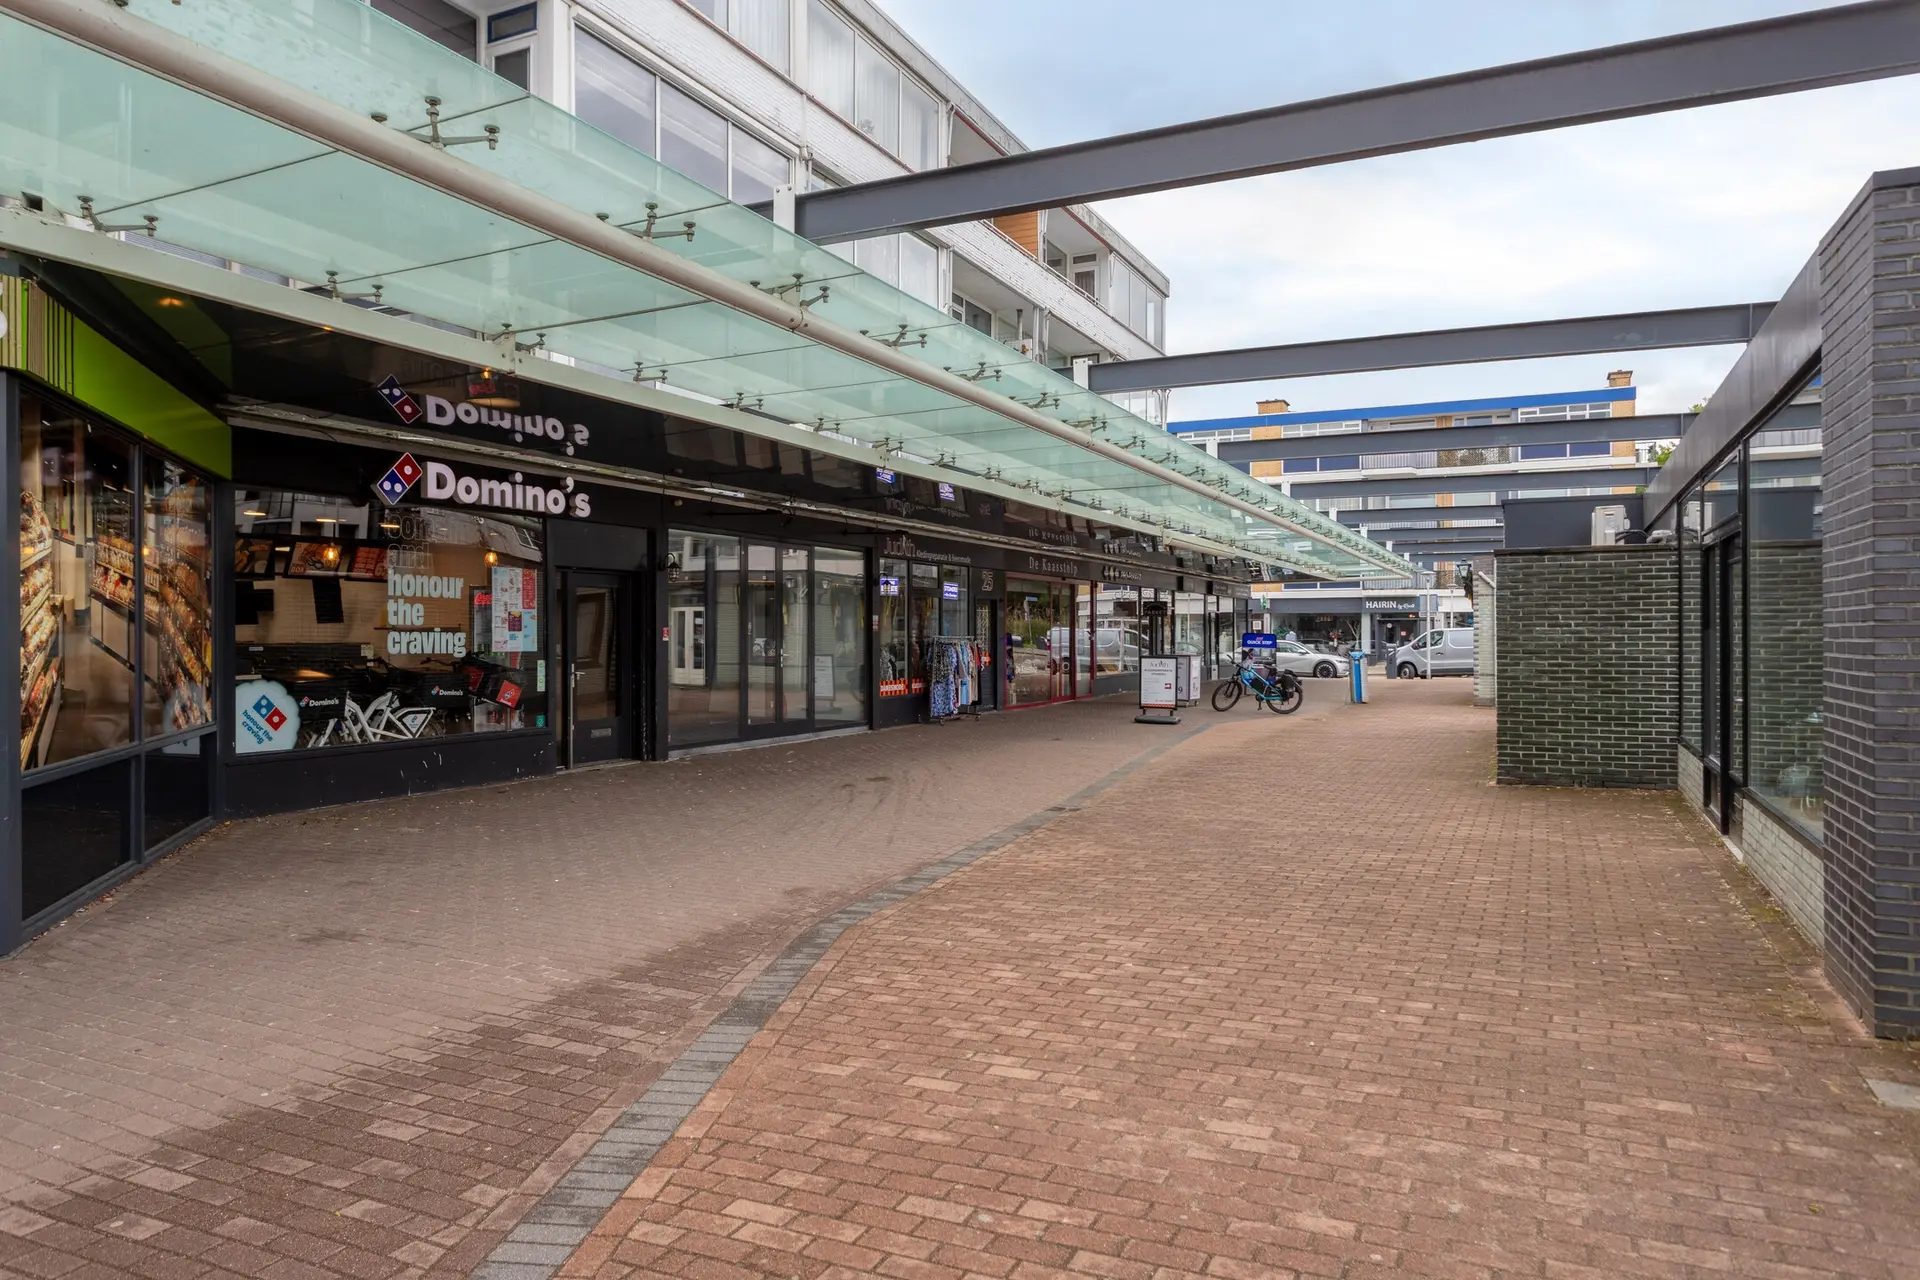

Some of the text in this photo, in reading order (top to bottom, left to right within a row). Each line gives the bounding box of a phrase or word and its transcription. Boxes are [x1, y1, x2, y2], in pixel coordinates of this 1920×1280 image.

[425, 461, 591, 518] Domino's
[1029, 556, 1039, 570] De
[388, 570, 464, 600] honour
[387, 598, 425, 626] the
[1365, 600, 1397, 609] HAIRIN
[387, 627, 466, 658] craving
[309, 697, 339, 707] Domino's
[241, 720, 264, 745] craving
[242, 709, 273, 742] honour the
